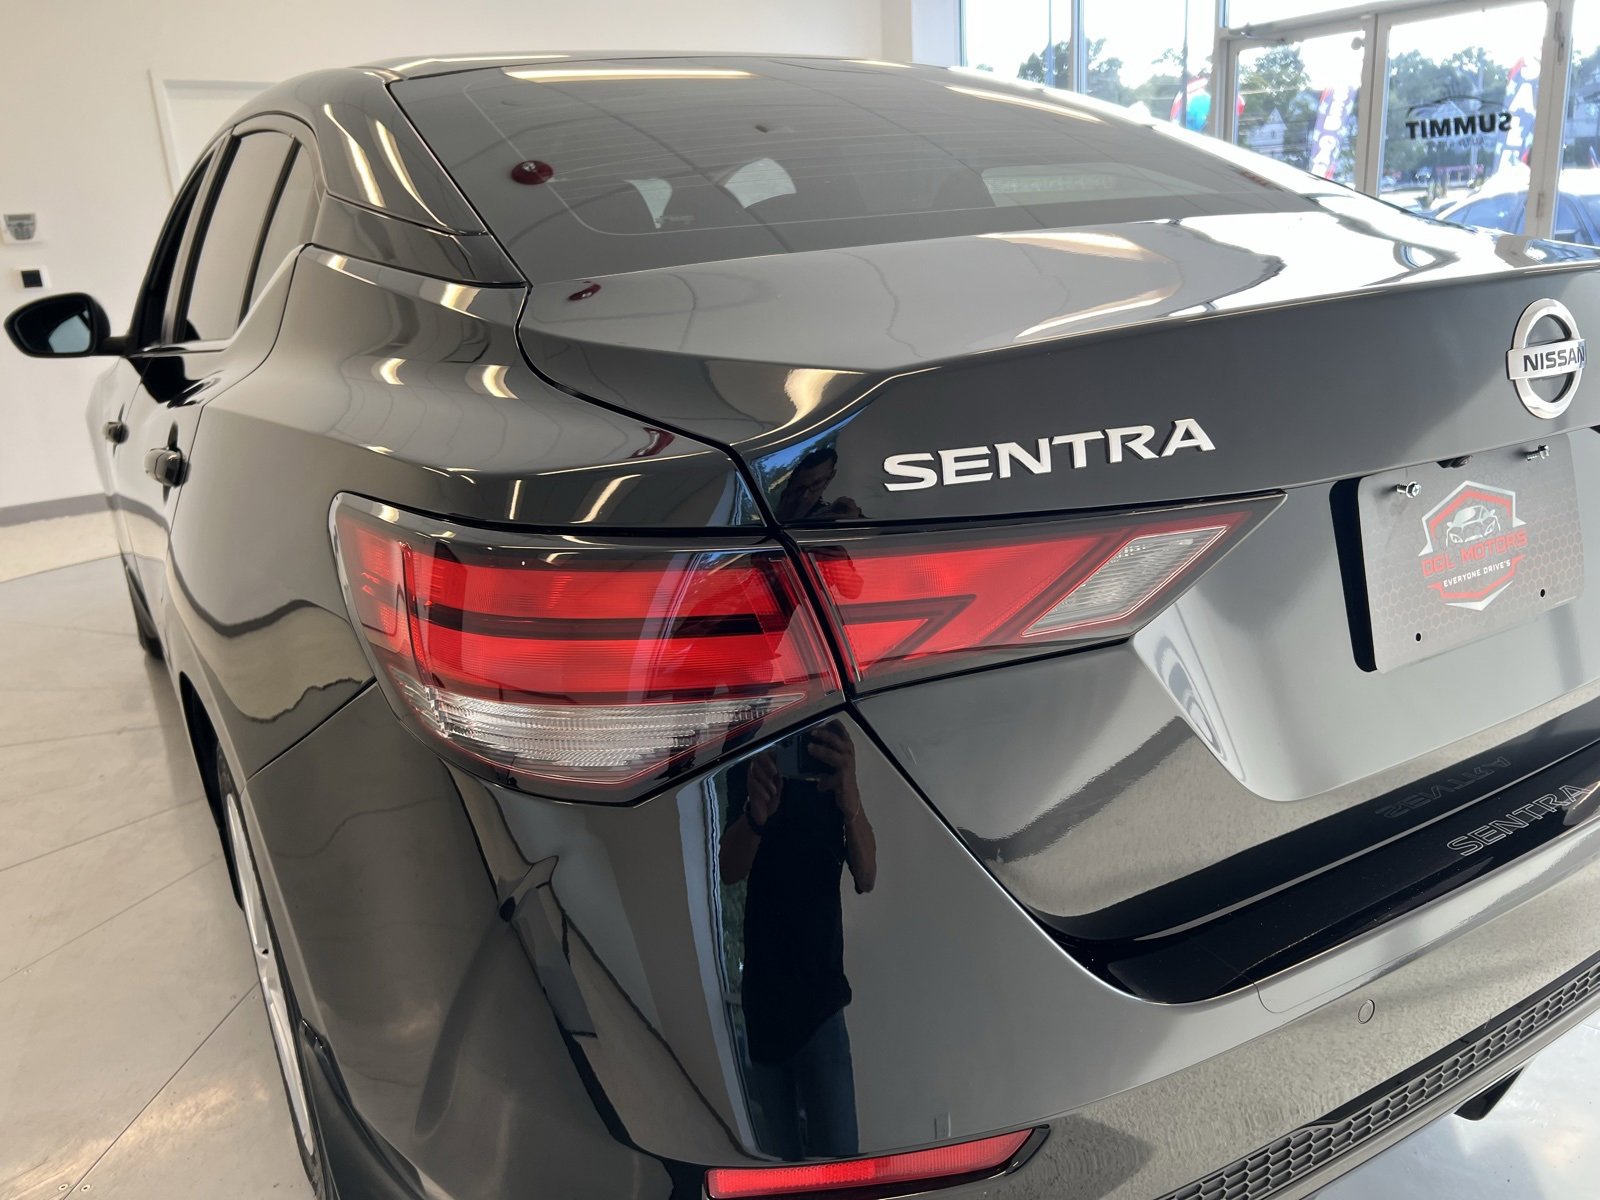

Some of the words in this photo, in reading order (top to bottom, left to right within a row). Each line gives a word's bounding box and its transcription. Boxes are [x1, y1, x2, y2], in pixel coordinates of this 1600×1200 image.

[1523, 345, 1585, 372] NISSAN
[883, 418, 1217, 492] SENTRA
[1460, 528, 1529, 563] MOTORS
[1443, 569, 1481, 588] EVERYONE
[1483, 559, 1511, 575] DRIVE'S
[1446, 784, 1592, 857] SENTRA
